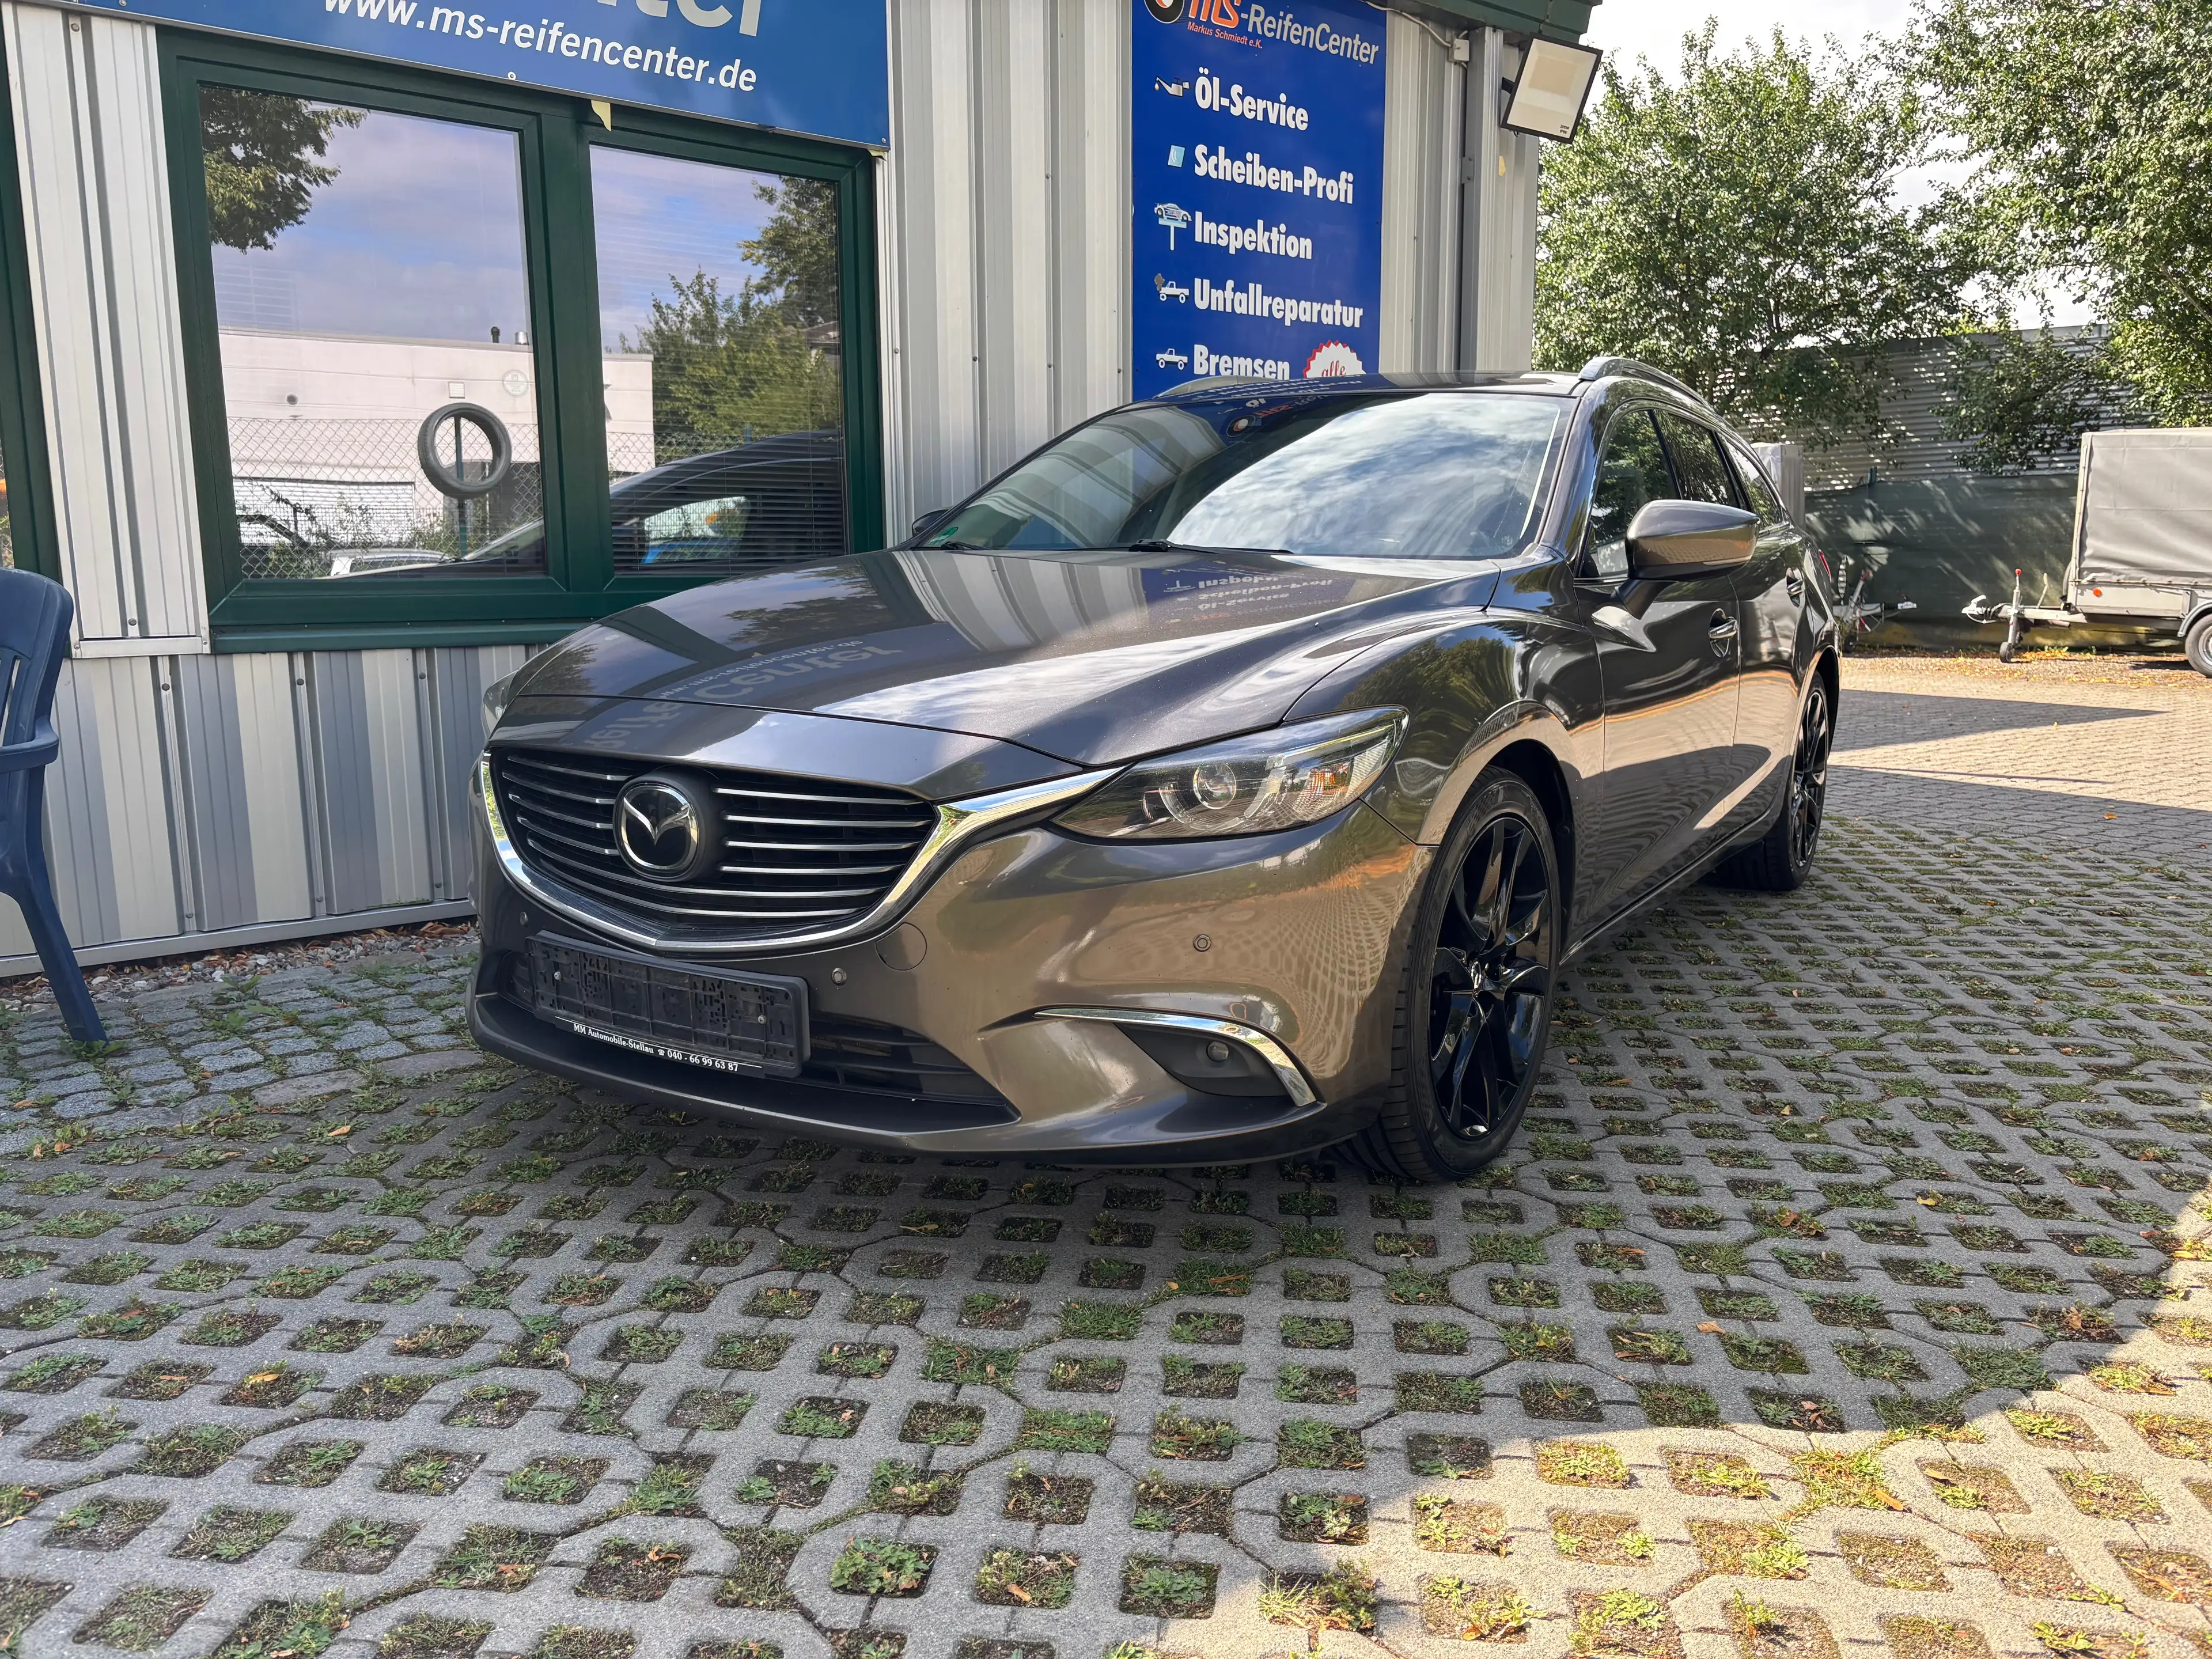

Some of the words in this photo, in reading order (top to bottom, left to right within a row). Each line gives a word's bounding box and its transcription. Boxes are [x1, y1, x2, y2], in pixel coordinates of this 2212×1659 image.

[325, 0, 757, 91] www.ms-reifencenter.de
[1187, 21, 1213, 36] Markus
[1215, 29, 1248, 45] Schmiedt
[1249, 39, 1263, 48] e.K.
[1195, 67, 1309, 131] Öl-Service
[1195, 144, 1354, 204] Scheiben-Profi
[1195, 211, 1312, 259] Inspektion
[1194, 278, 1363, 328] Unfallreparatur
[1194, 344, 1290, 380] Bremsen
[1321, 361, 1346, 377] alle
[573, 1023, 586, 1035] MM
[588, 1028, 654, 1054] Automobile-Stellau
[667, 1050, 683, 1060] 040
[690, 1055, 700, 1064] 66
[702, 1057, 713, 1066] 99
[715, 1060, 726, 1069] 63
[728, 1063, 738, 1072] 87
